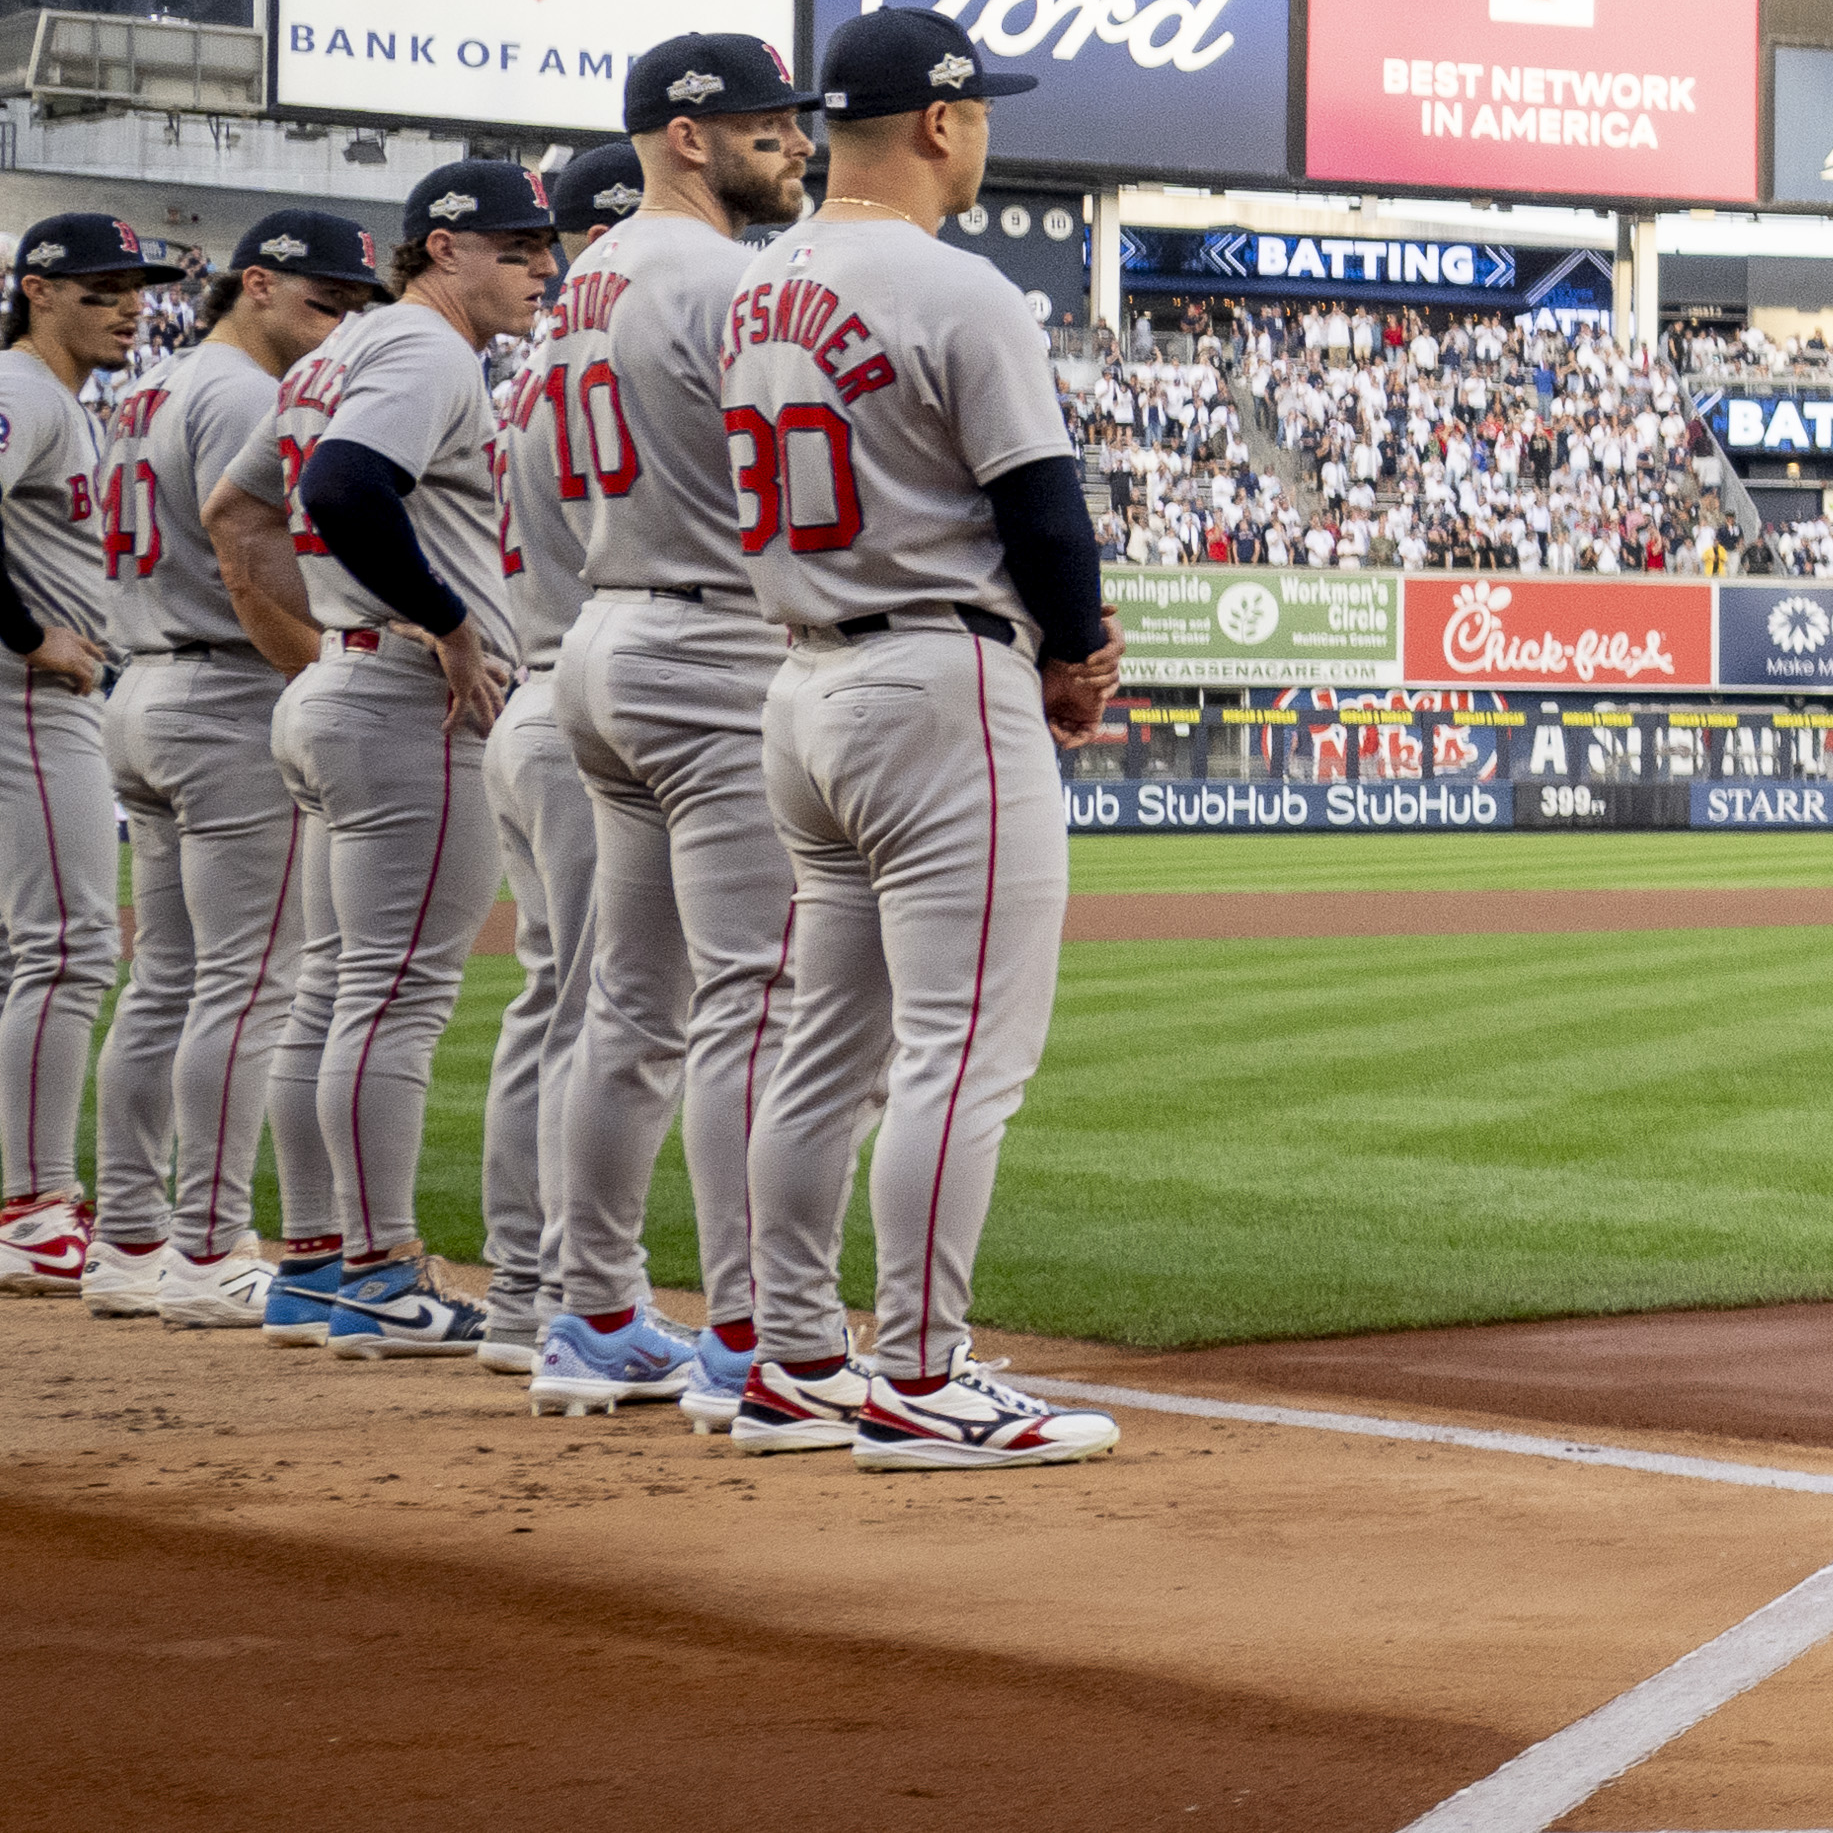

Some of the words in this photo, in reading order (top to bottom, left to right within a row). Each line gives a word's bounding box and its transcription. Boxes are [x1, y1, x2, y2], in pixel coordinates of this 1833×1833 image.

[289, 22, 437, 65] BANK
[456, 38, 521, 69] OF
[1382, 57, 1484, 100] BEST
[1491, 65, 1697, 113] NETWORK
[1421, 101, 1464, 139] IN
[1471, 106, 1660, 150] AMERICA
[1256, 236, 1477, 286] BATTING
[543, 357, 644, 501] 10
[721, 402, 864, 557] 30
[1103, 574, 1212, 609] orningside
[1120, 659, 1377, 680] WW.CASSENACARE.COM
[1766, 656, 1815, 677] Make
[1138, 784, 1309, 827] StubHub
[1325, 784, 1498, 826] StubHub
[1707, 788, 1829, 824] STARR
